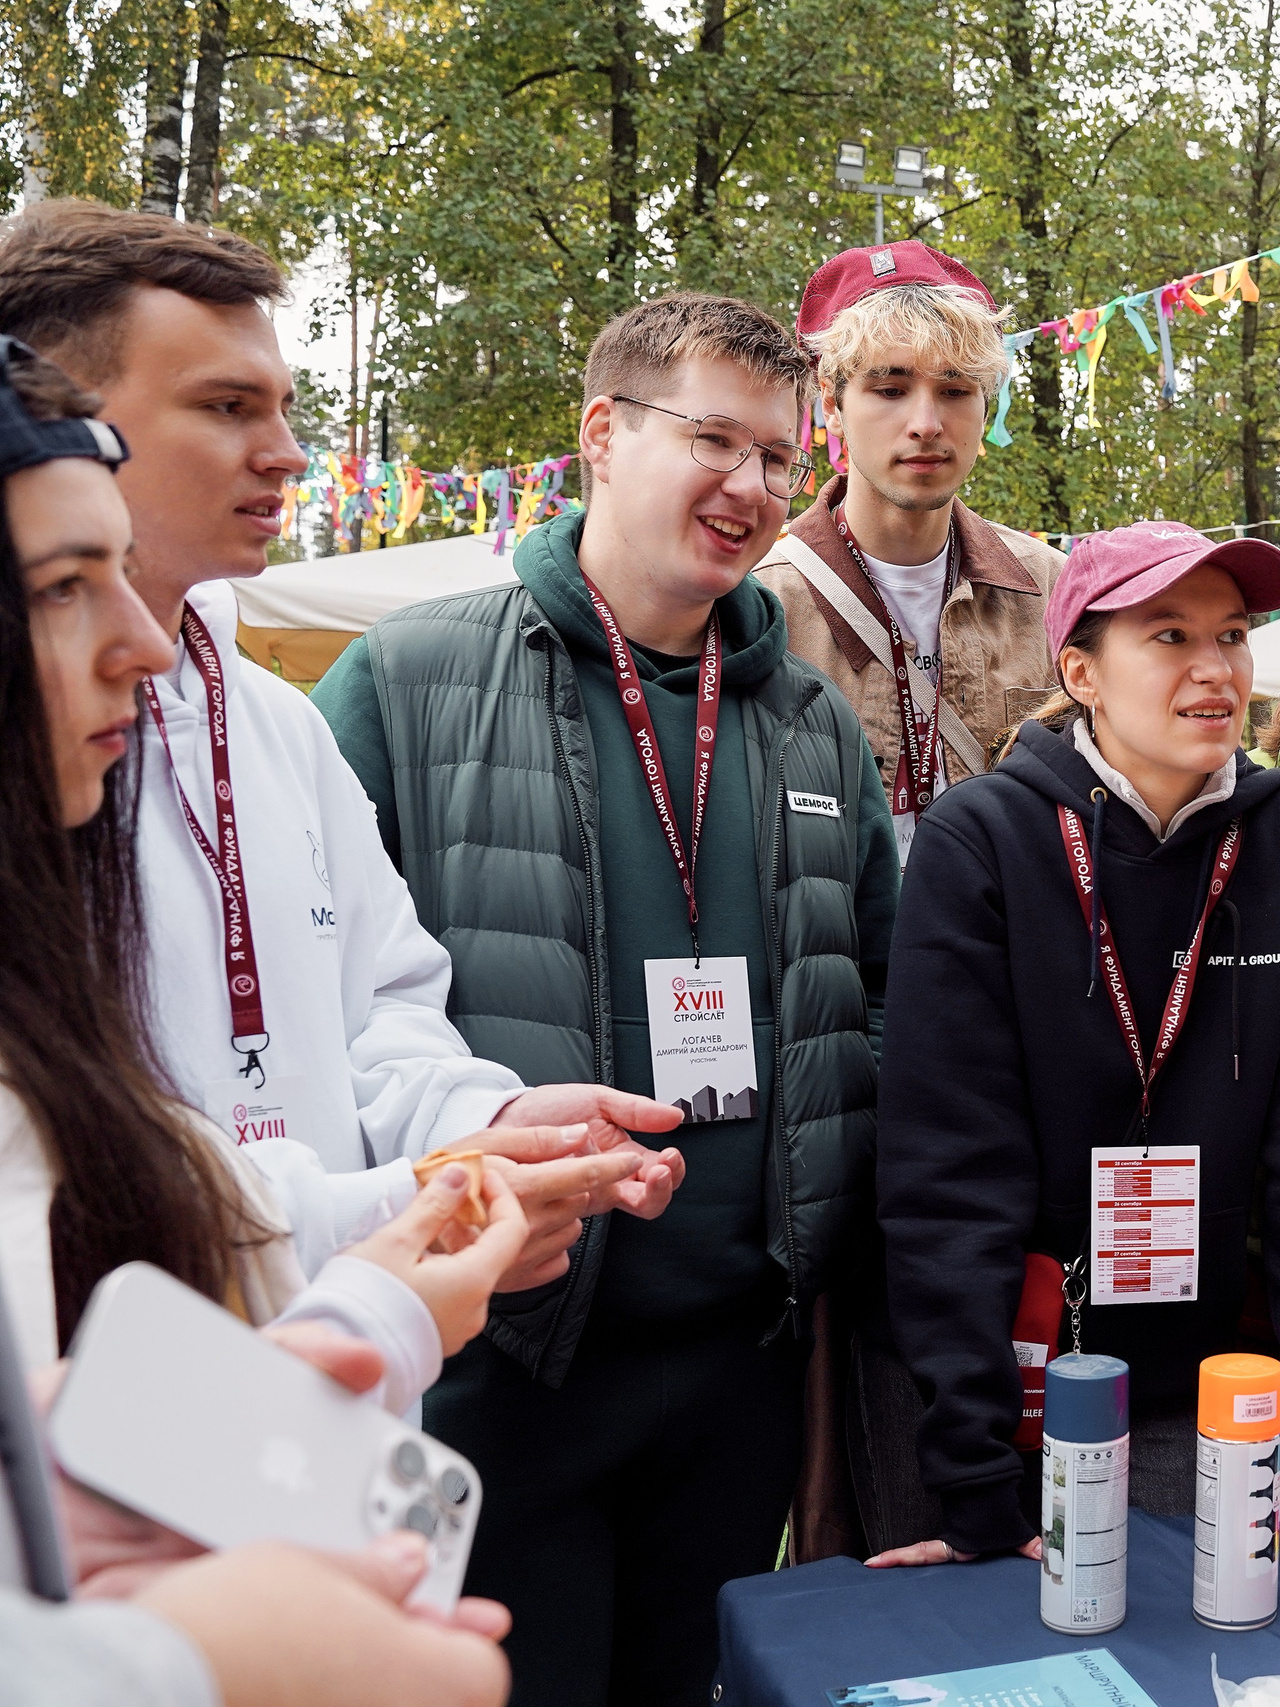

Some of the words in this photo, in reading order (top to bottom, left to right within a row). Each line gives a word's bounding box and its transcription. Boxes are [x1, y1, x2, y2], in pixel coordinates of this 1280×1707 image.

[594, 602, 628, 669] ФУНДАМЕНТ
[620, 671, 631, 680] Я
[702, 656, 717, 702] ГОРОДА
[211, 681, 226, 747] ГОРОДА
[902, 697, 920, 761] ФУНДАМЕНТ
[636, 728, 658, 780] ГОРОДА
[700, 750, 710, 759] Я
[694, 761, 708, 837] ФУНДАМЕНТ
[793, 796, 834, 811] ЦЕМРОС
[222, 813, 233, 823] Я
[651, 783, 682, 859] ФУНДАМЕНТ
[678, 861, 685, 869] Я
[1072, 841, 1094, 895] ГОРОДА
[1219, 861, 1228, 871] Я
[231, 951, 246, 961] Я
[1100, 945, 1111, 954] Я
[1104, 955, 1135, 1031] ФУНДАМЕНТ
[673, 990, 724, 1012] XVIII
[673, 1011, 725, 1023] СТРОЙСЛЁТ
[1161, 973, 1189, 1050] ФУНДАМЕНТ
[681, 1034, 722, 1045] ЛОГАЧЕВ
[656, 1046, 689, 1057] ДМИТРИЙ
[689, 1044, 748, 1054] АЛЕКСАНДРОВИЧ
[690, 1056, 718, 1065] участник
[235, 1118, 286, 1146] XVIII
[1022, 1408, 1043, 1418] ЩЕЕ
